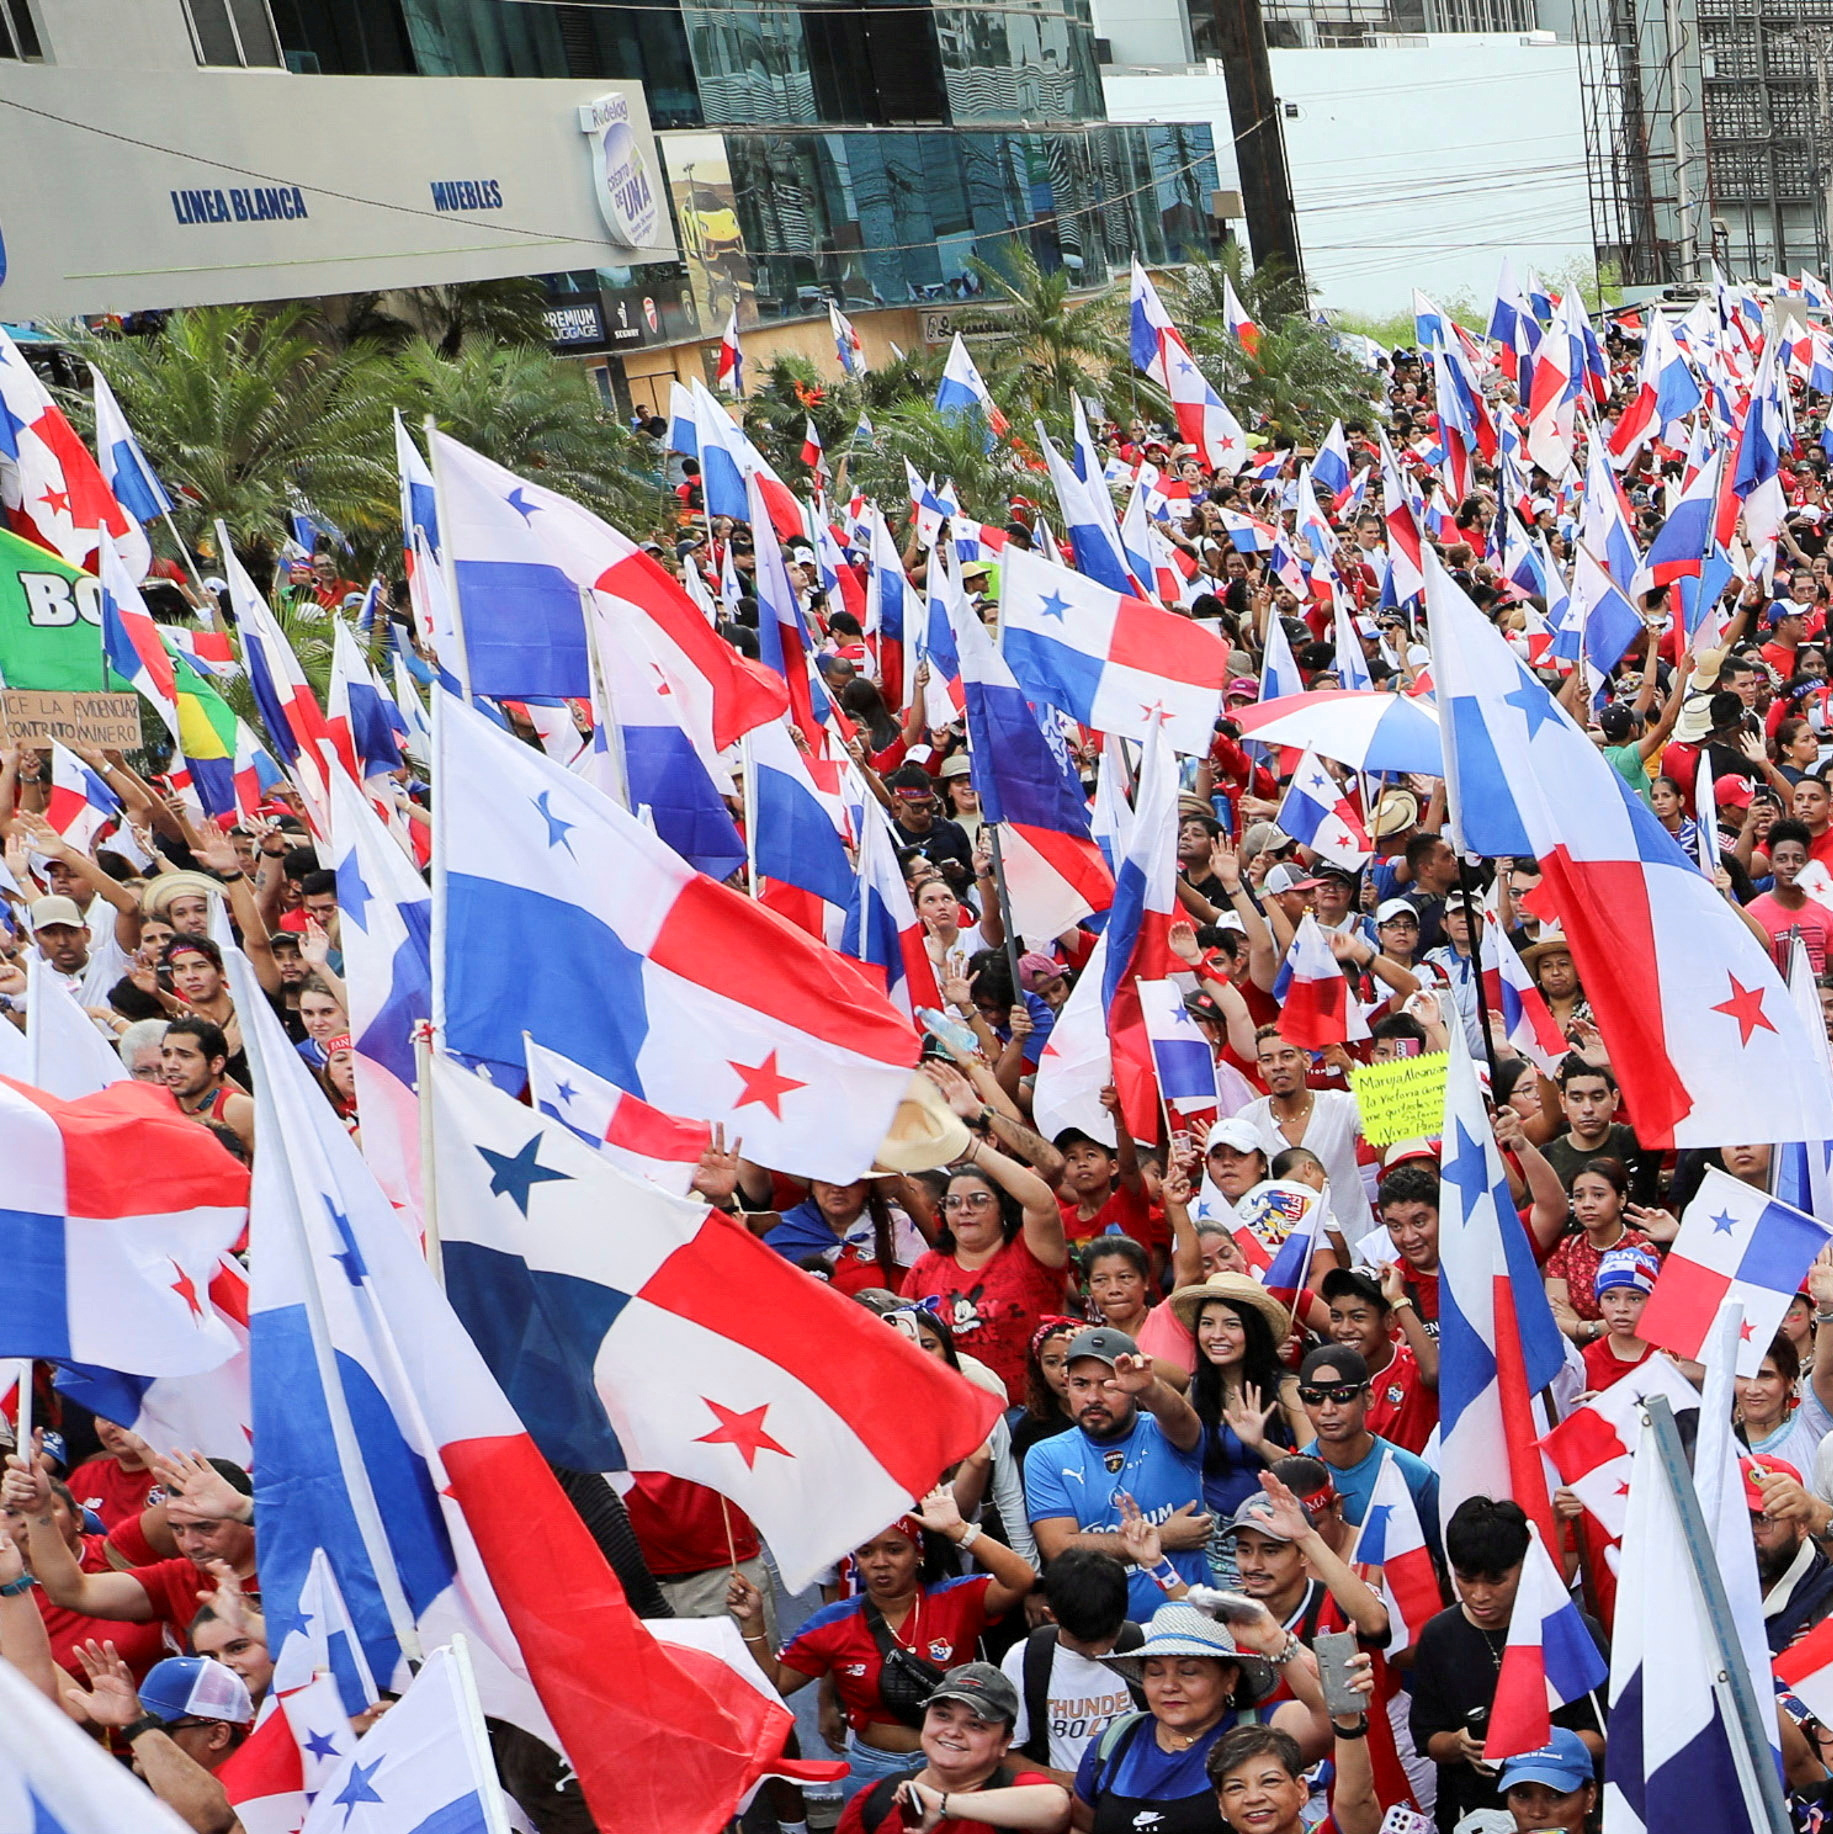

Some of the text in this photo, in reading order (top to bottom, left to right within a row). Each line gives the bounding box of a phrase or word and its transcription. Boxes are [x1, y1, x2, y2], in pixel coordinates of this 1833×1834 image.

[170, 187, 308, 224] LINEA BLANCA
[430, 180, 503, 212] MUEBLES
[621, 170, 652, 222] UNA
[41, 699, 64, 714] LA
[8, 722, 137, 745] CONTRATO MINERO
[1360, 1073, 1404, 1092] Maruja
[1047, 1690, 1130, 1719] THUNDE
